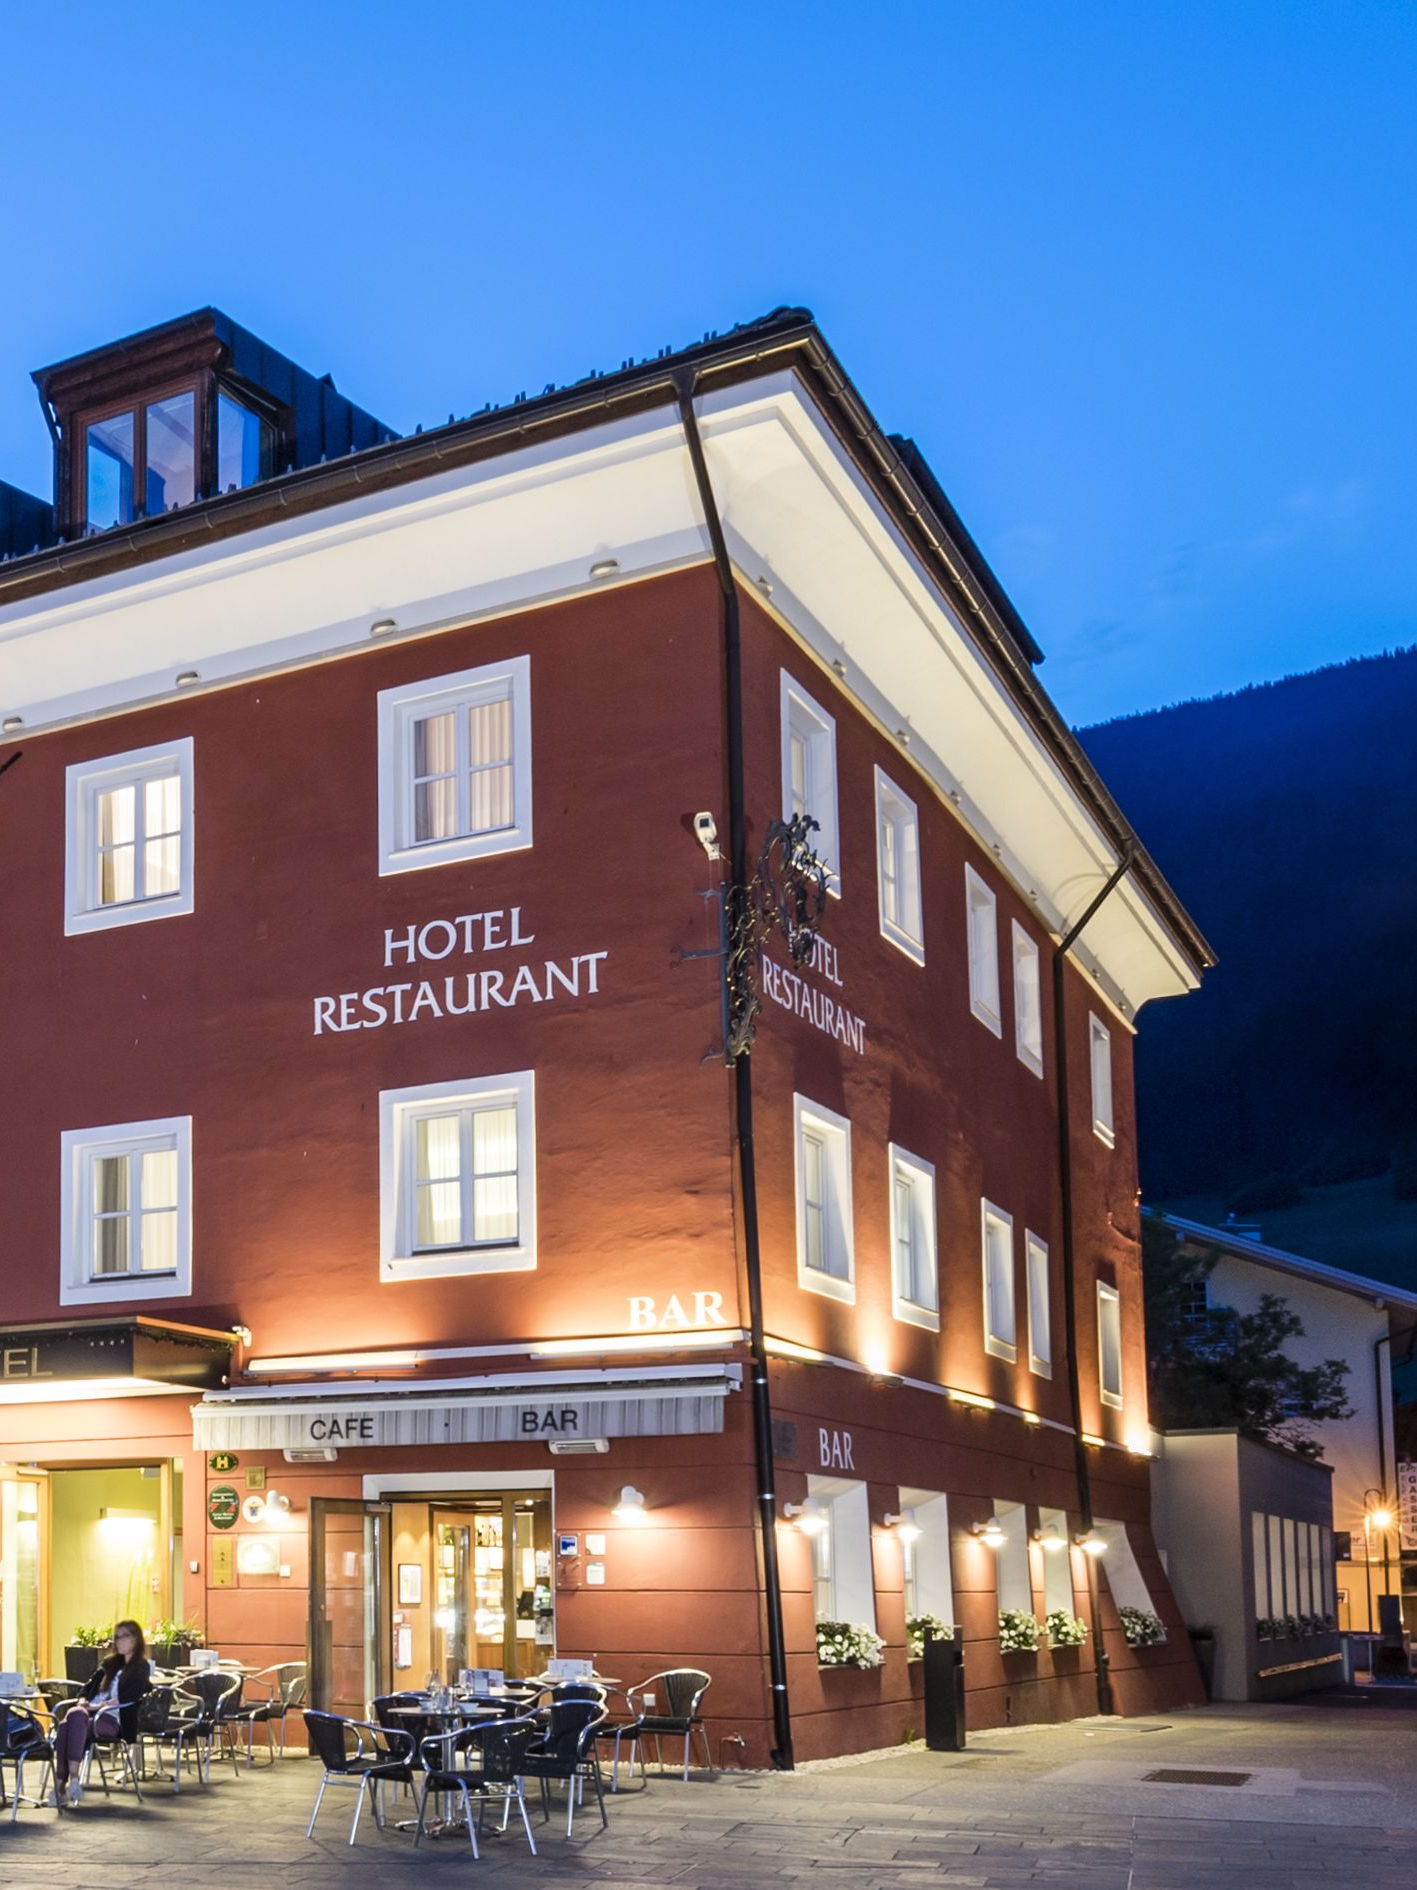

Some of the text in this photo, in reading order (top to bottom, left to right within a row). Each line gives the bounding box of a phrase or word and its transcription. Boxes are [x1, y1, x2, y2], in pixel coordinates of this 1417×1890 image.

[384, 906, 535, 967] HOTEL
[313, 951, 608, 1035] RESTAURANT
[762, 954, 866, 1055] RESTAURANT
[626, 1290, 728, 1331] BAR
[310, 1410, 578, 1440] CAFE BAR
[216, 1456, 229, 1469] H
[819, 1427, 855, 1471] BAR
